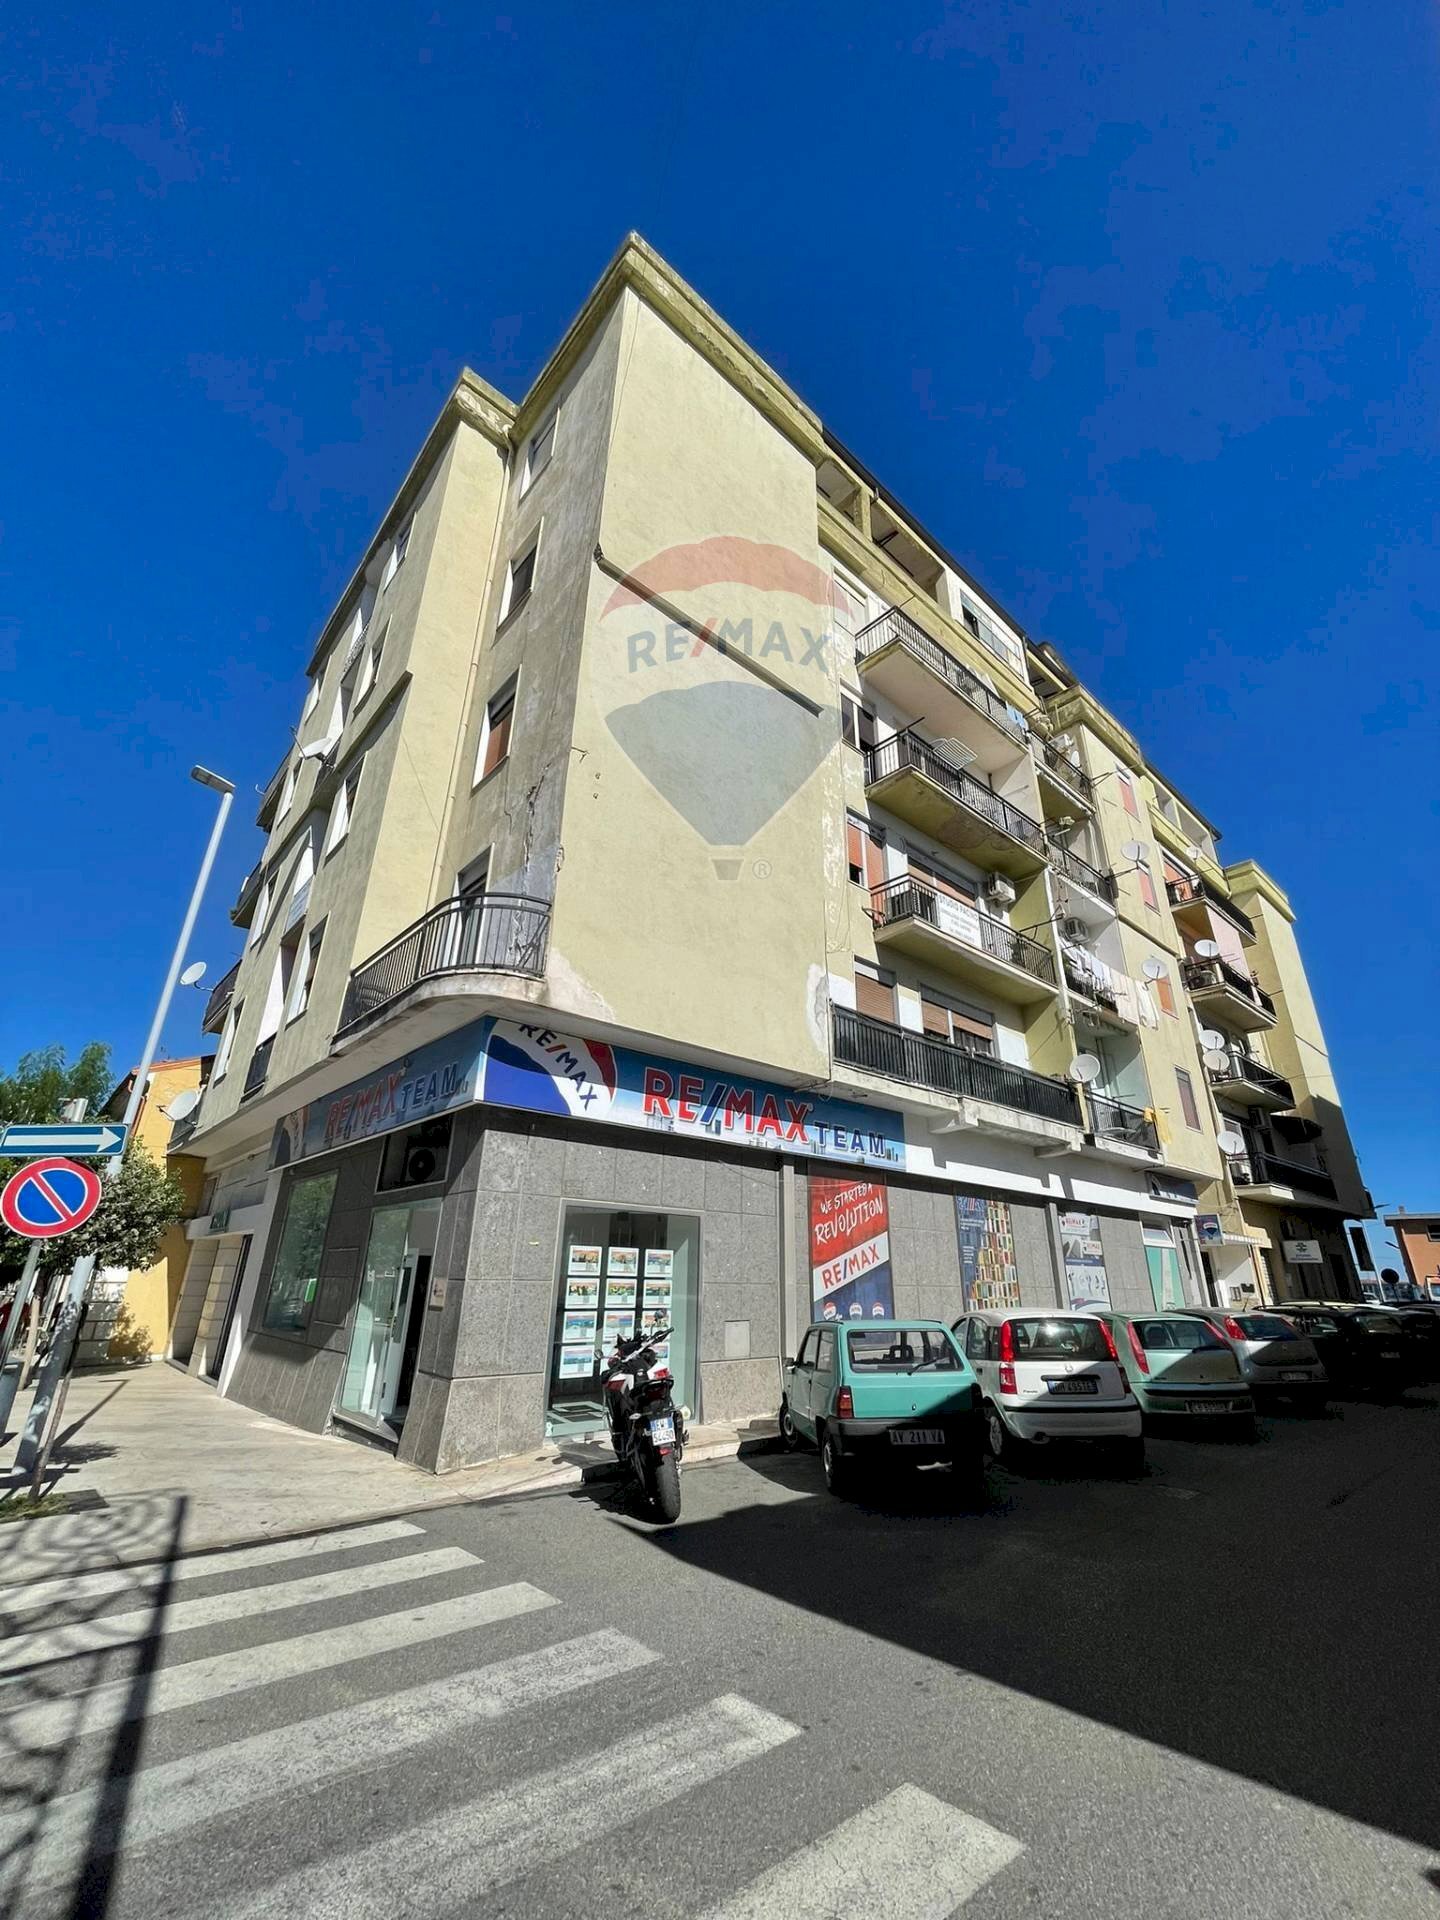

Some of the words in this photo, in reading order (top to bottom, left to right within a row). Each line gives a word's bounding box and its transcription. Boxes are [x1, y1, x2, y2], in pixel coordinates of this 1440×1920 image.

[400, 1060, 460, 1112] TEAM
[642, 1066, 810, 1144] RE/MAX
[813, 1120, 887, 1158] TEAM
[814, 1192, 884, 1245] REVOLUTION
[820, 1199, 833, 1214] WE
[834, 1184, 866, 1209] STARTED
[822, 1243, 880, 1289] RE/MAX
